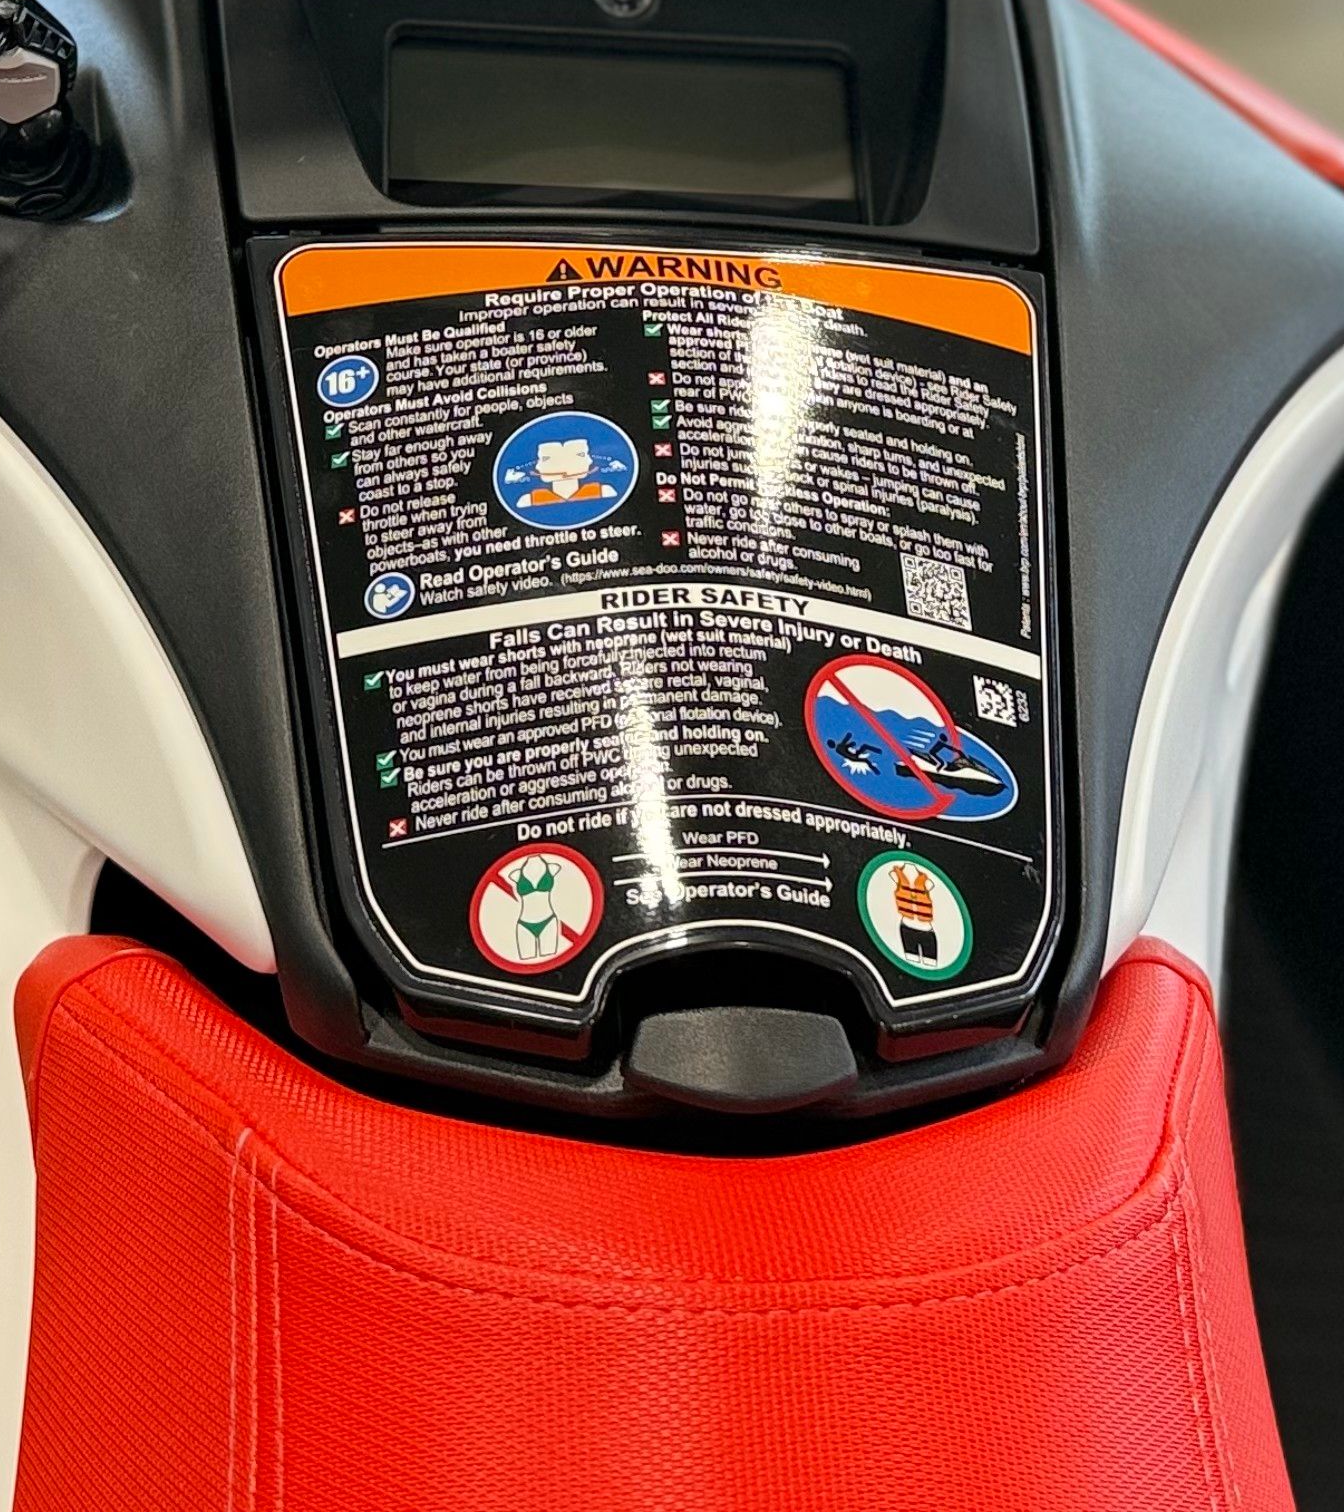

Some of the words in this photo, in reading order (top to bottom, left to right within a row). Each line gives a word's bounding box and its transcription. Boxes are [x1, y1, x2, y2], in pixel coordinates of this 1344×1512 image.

[586, 256, 782, 288] WARNING
[459, 307, 528, 322] Improper
[532, 299, 606, 317] operation
[610, 298, 638, 308] can
[644, 298, 686, 308] result
[690, 297, 704, 308] in
[485, 290, 562, 307] Require
[568, 285, 636, 304] Proper
[640, 283, 736, 302] Operation
[642, 310, 692, 322] Protect
[696, 312, 714, 324] All
[314, 338, 381, 358] Operators
[386, 332, 418, 347] Must
[422, 330, 440, 342] Be
[444, 321, 506, 340] Qualified
[386, 346, 420, 359] Make
[424, 342, 452, 354] sure
[456, 334, 508, 352] operator
[514, 332, 524, 343] is
[529, 330, 544, 342] 16
[548, 330, 561, 340] or
[564, 326, 597, 338] older
[386, 359, 410, 371] and
[414, 354, 437, 368] has
[442, 349, 476, 363] taken
[480, 350, 488, 358] a
[492, 344, 532, 358] boater
[536, 340, 576, 354] safety
[386, 370, 433, 382] course.
[436, 364, 466, 376] Your
[470, 359, 501, 372] state
[506, 357, 525, 370] (or
[528, 350, 587, 367] province)
[325, 366, 370, 396] 16+
[386, 384, 414, 398] may
[418, 378, 449, 392] have
[452, 370, 515, 387] additional
[518, 361, 608, 380] requirements.
[324, 402, 392, 426] Operators
[396, 396, 430, 413] Must
[432, 390, 473, 406] Avoid
[477, 382, 547, 400] Collisions
[348, 419, 381, 434] Scan
[385, 410, 449, 431] constantly
[453, 406, 472, 418] for
[475, 398, 522, 416] people,
[526, 393, 574, 409] objects
[350, 432, 374, 446] and
[378, 426, 412, 440] other
[415, 416, 483, 436] watercraft.
[352, 448, 380, 463] Stay
[384, 445, 401, 458] far
[405, 436, 454, 455] enough
[458, 431, 492, 446] away
[353, 461, 383, 476] from
[386, 454, 427, 468] others
[431, 452, 447, 462] so
[451, 448, 474, 463] you
[356, 475, 380, 488] can
[384, 468, 428, 486] always
[432, 460, 471, 479] safely
[358, 488, 394, 502] coast
[398, 485, 409, 496] to
[414, 484, 422, 492] a
[426, 478, 458, 494] stop.
[656, 473, 677, 485] Do
[680, 472, 706, 486] Not
[710, 473, 754, 490] Permit
[822, 491, 890, 517] Operation:
[360, 504, 379, 518] Do
[382, 500, 403, 514] not
[406, 494, 456, 510] release
[362, 514, 408, 532] throttle
[412, 508, 446, 522] when
[450, 502, 488, 520] trying
[365, 534, 377, 546] to
[380, 528, 414, 544] steer
[418, 523, 451, 538] away
[456, 515, 488, 529] from
[442, 531, 468, 548] with
[472, 526, 507, 541] other
[370, 550, 450, 576] powerboats,
[454, 546, 482, 562] you
[486, 539, 521, 554] need
[524, 530, 577, 550] throttle
[581, 529, 596, 542] to
[600, 525, 642, 540] steer.
[687, 532, 729, 546] Never
[731, 533, 756, 548] ride
[760, 538, 789, 555] after
[792, 544, 861, 572] consuming
[689, 546, 737, 561] alcohol
[740, 551, 754, 563] or
[758, 553, 797, 570] drugs.
[420, 570, 464, 589] Read
[468, 555, 562, 584] Operator's
[566, 548, 618, 568] Guide
[420, 586, 464, 606] Watch
[468, 579, 508, 597] safety
[512, 574, 553, 592] video.
[601, 588, 691, 610] RIDER
[701, 588, 809, 615] SAFETY
[490, 628, 540, 648] Falls
[547, 622, 590, 639] Can
[597, 611, 668, 634] Result
[673, 610, 694, 627] in
[699, 611, 772, 633] Severe
[777, 618, 835, 647] Injury
[840, 634, 860, 648] or
[866, 636, 921, 664] Death
[386, 669, 415, 683] You
[418, 664, 456, 678] must
[458, 656, 494, 672] wear
[498, 647, 546, 666] shorts
[550, 642, 582, 655] with
[586, 631, 656, 652] neoprene
[661, 630, 693, 647] (wet
[697, 630, 725, 643] suit
[729, 633, 791, 654] material)
[399, 747, 426, 764] You
[428, 740, 462, 757] must
[464, 734, 494, 750] wear
[498, 731, 515, 742] an
[516, 719, 578, 742] approved
[582, 714, 612, 730] PFD
[517, 823, 542, 841] Do
[546, 817, 574, 837] not
[579, 812, 612, 831] ride
[616, 808, 628, 825] if
[702, 803, 731, 819] not
[735, 803, 801, 825] dressed
[805, 812, 912, 849] appropriately.
[682, 832, 723, 845] Wear
[726, 832, 759, 845] PFD
[706, 855, 777, 870] Neoprene
[777, 884, 830, 908] Guide
